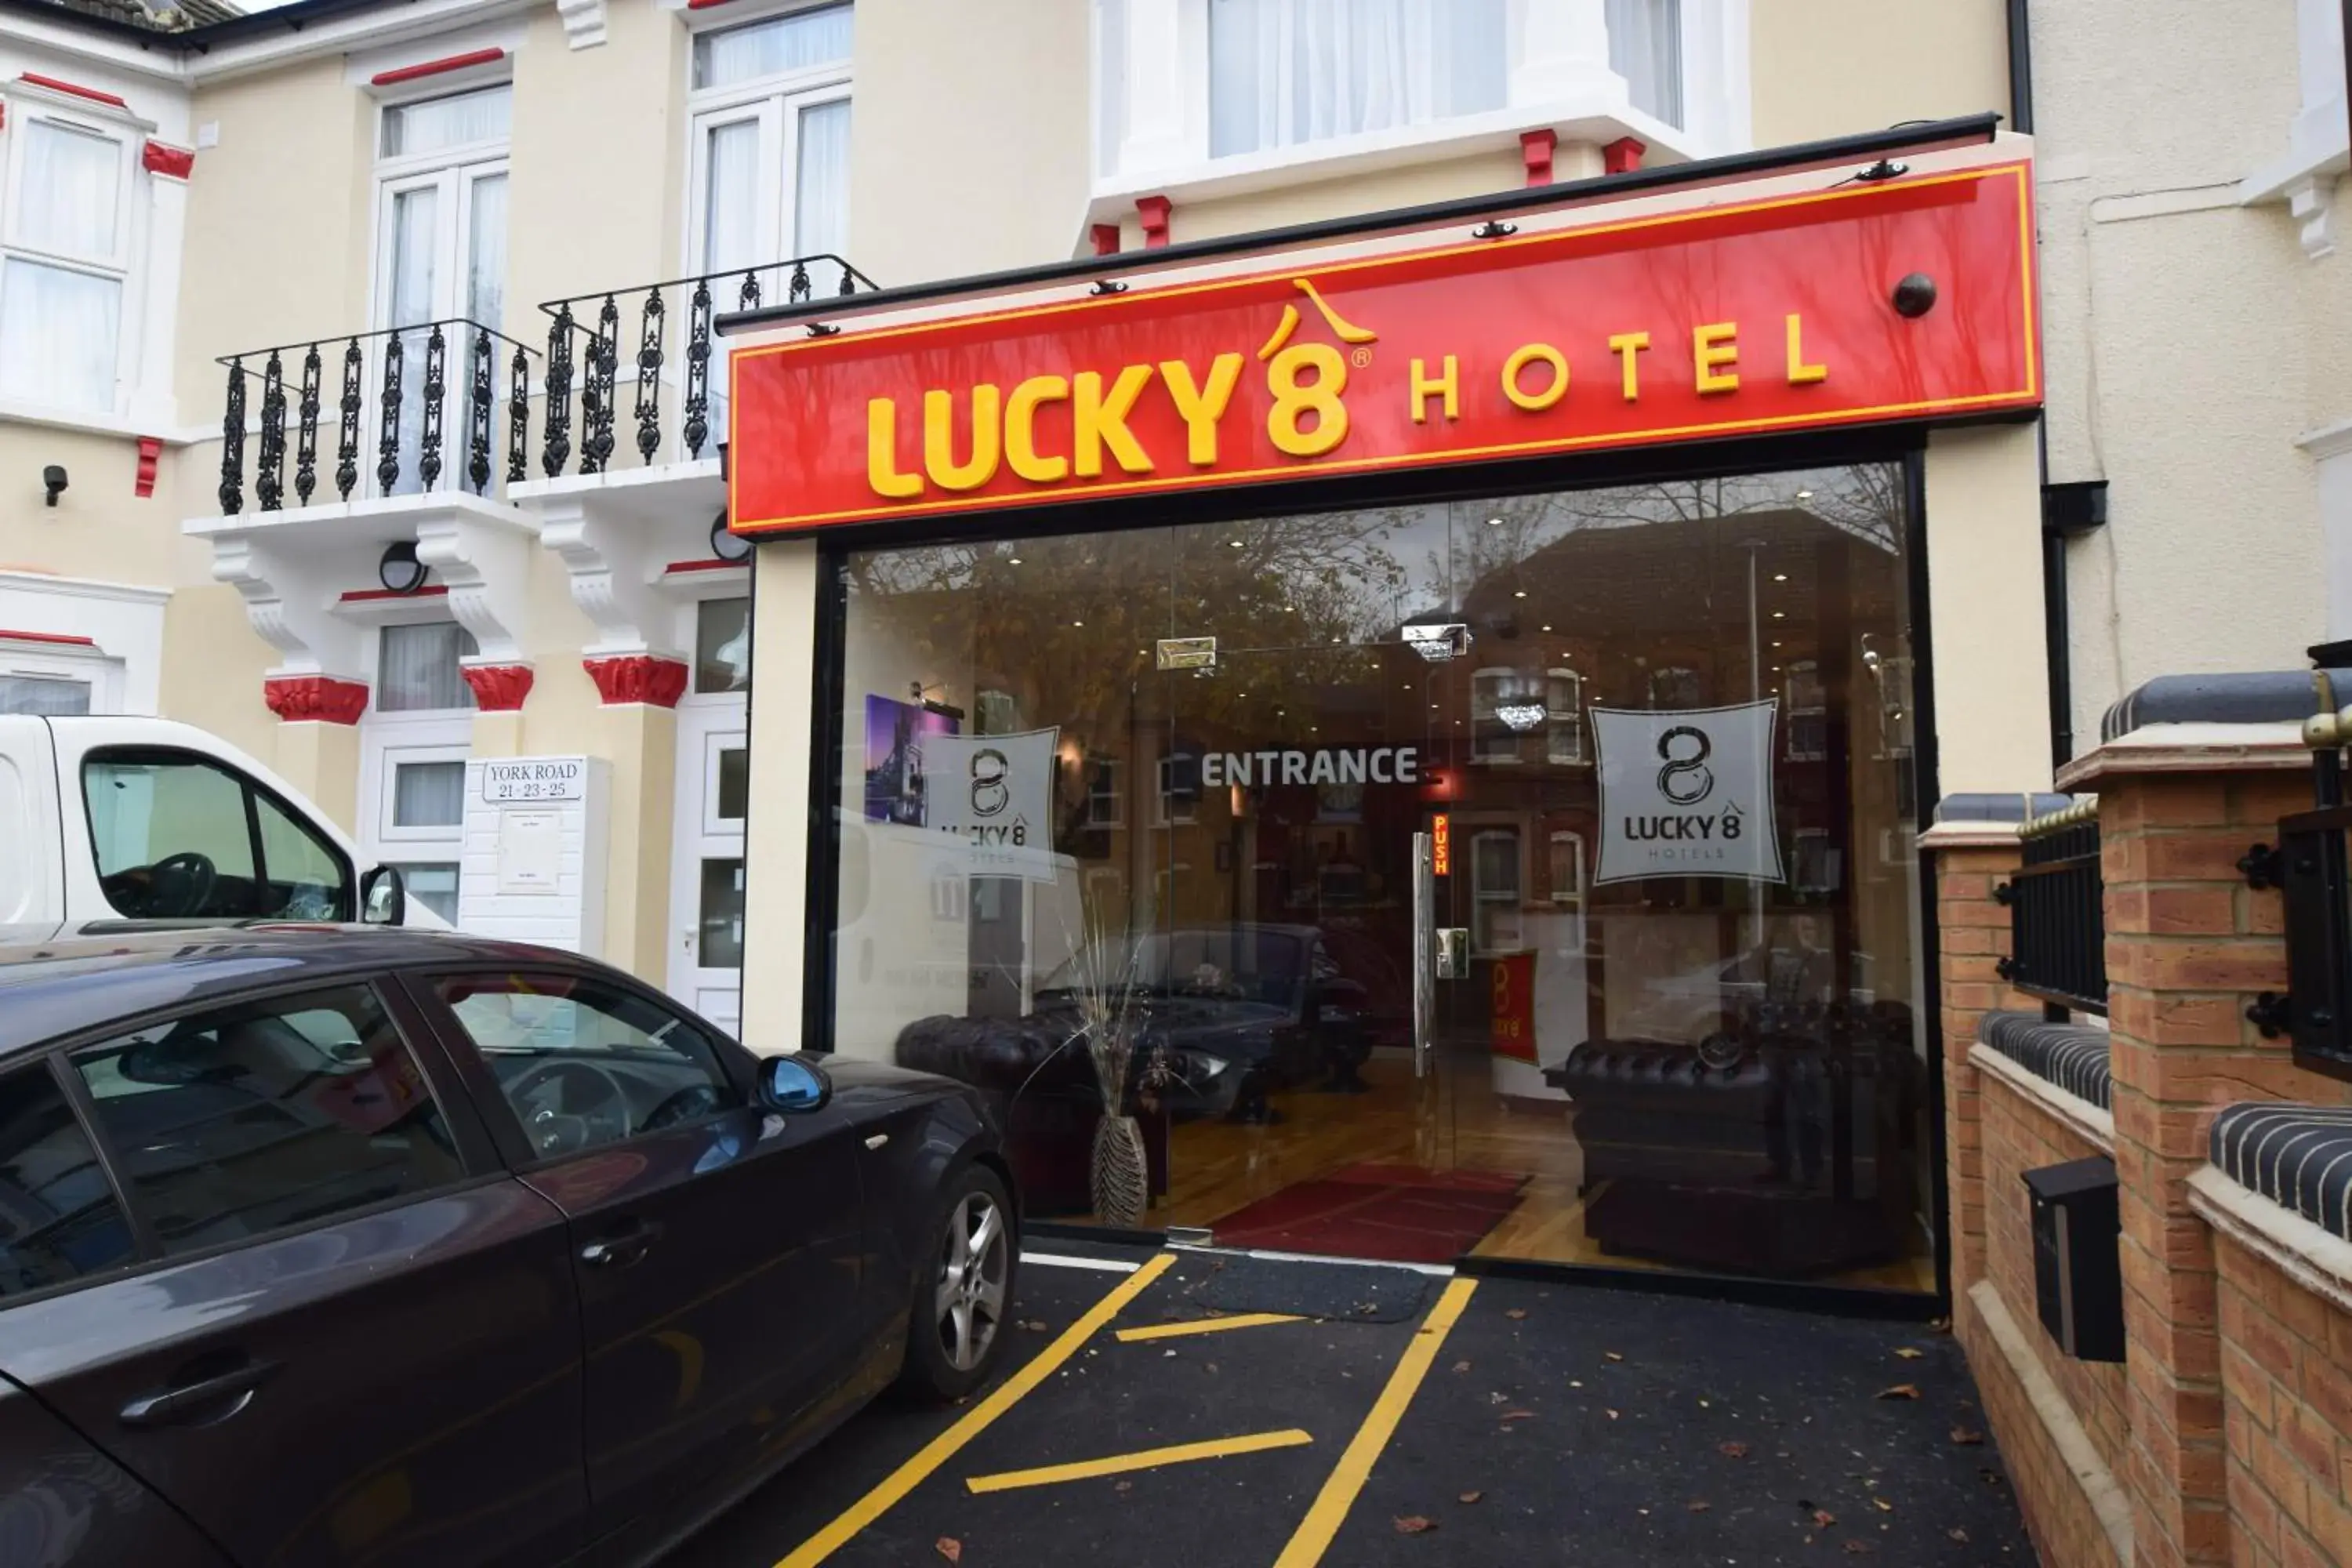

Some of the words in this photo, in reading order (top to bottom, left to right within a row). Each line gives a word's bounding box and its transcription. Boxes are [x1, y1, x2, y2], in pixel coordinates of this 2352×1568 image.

[868, 352, 1243, 498] LUCKY
[1267, 343, 1348, 456] 8
[1411, 313, 1828, 425] HOTEL
[491, 765, 531, 782] YORK
[535, 764, 578, 780] ROAD
[1202, 747, 1417, 786] ENTRANCE
[1012, 826, 1026, 847] 8
[1624, 815, 1715, 840] LUCKY
[1722, 815, 1741, 840] 8
[1436, 816, 1446, 874] PUSH
[1650, 848, 1725, 860] HOTELS
